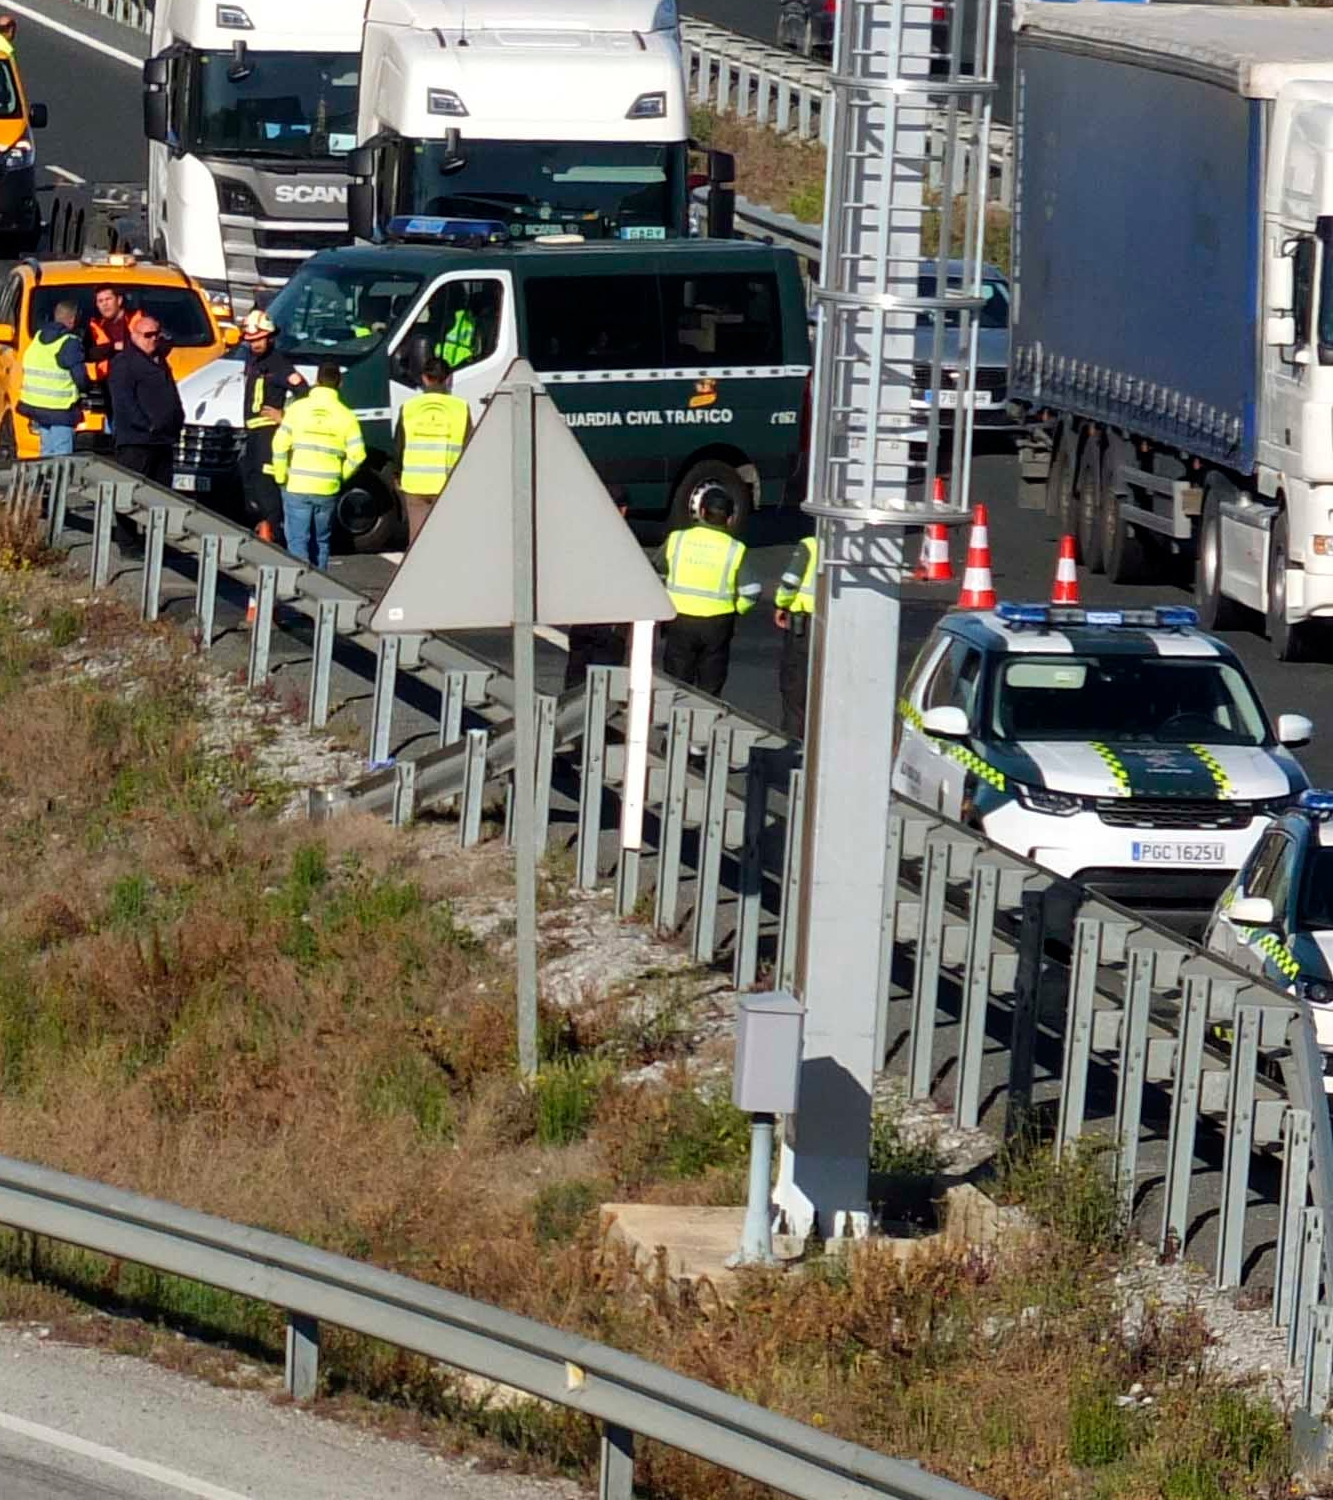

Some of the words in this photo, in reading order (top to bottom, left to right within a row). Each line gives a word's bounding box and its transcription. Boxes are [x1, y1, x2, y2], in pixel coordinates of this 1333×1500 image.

[275, 186, 348, 204] SCAN
[626, 410, 662, 426] CIVIL
[666, 409, 733, 425] TRAFICO
[1141, 844, 1172, 861] PGC
